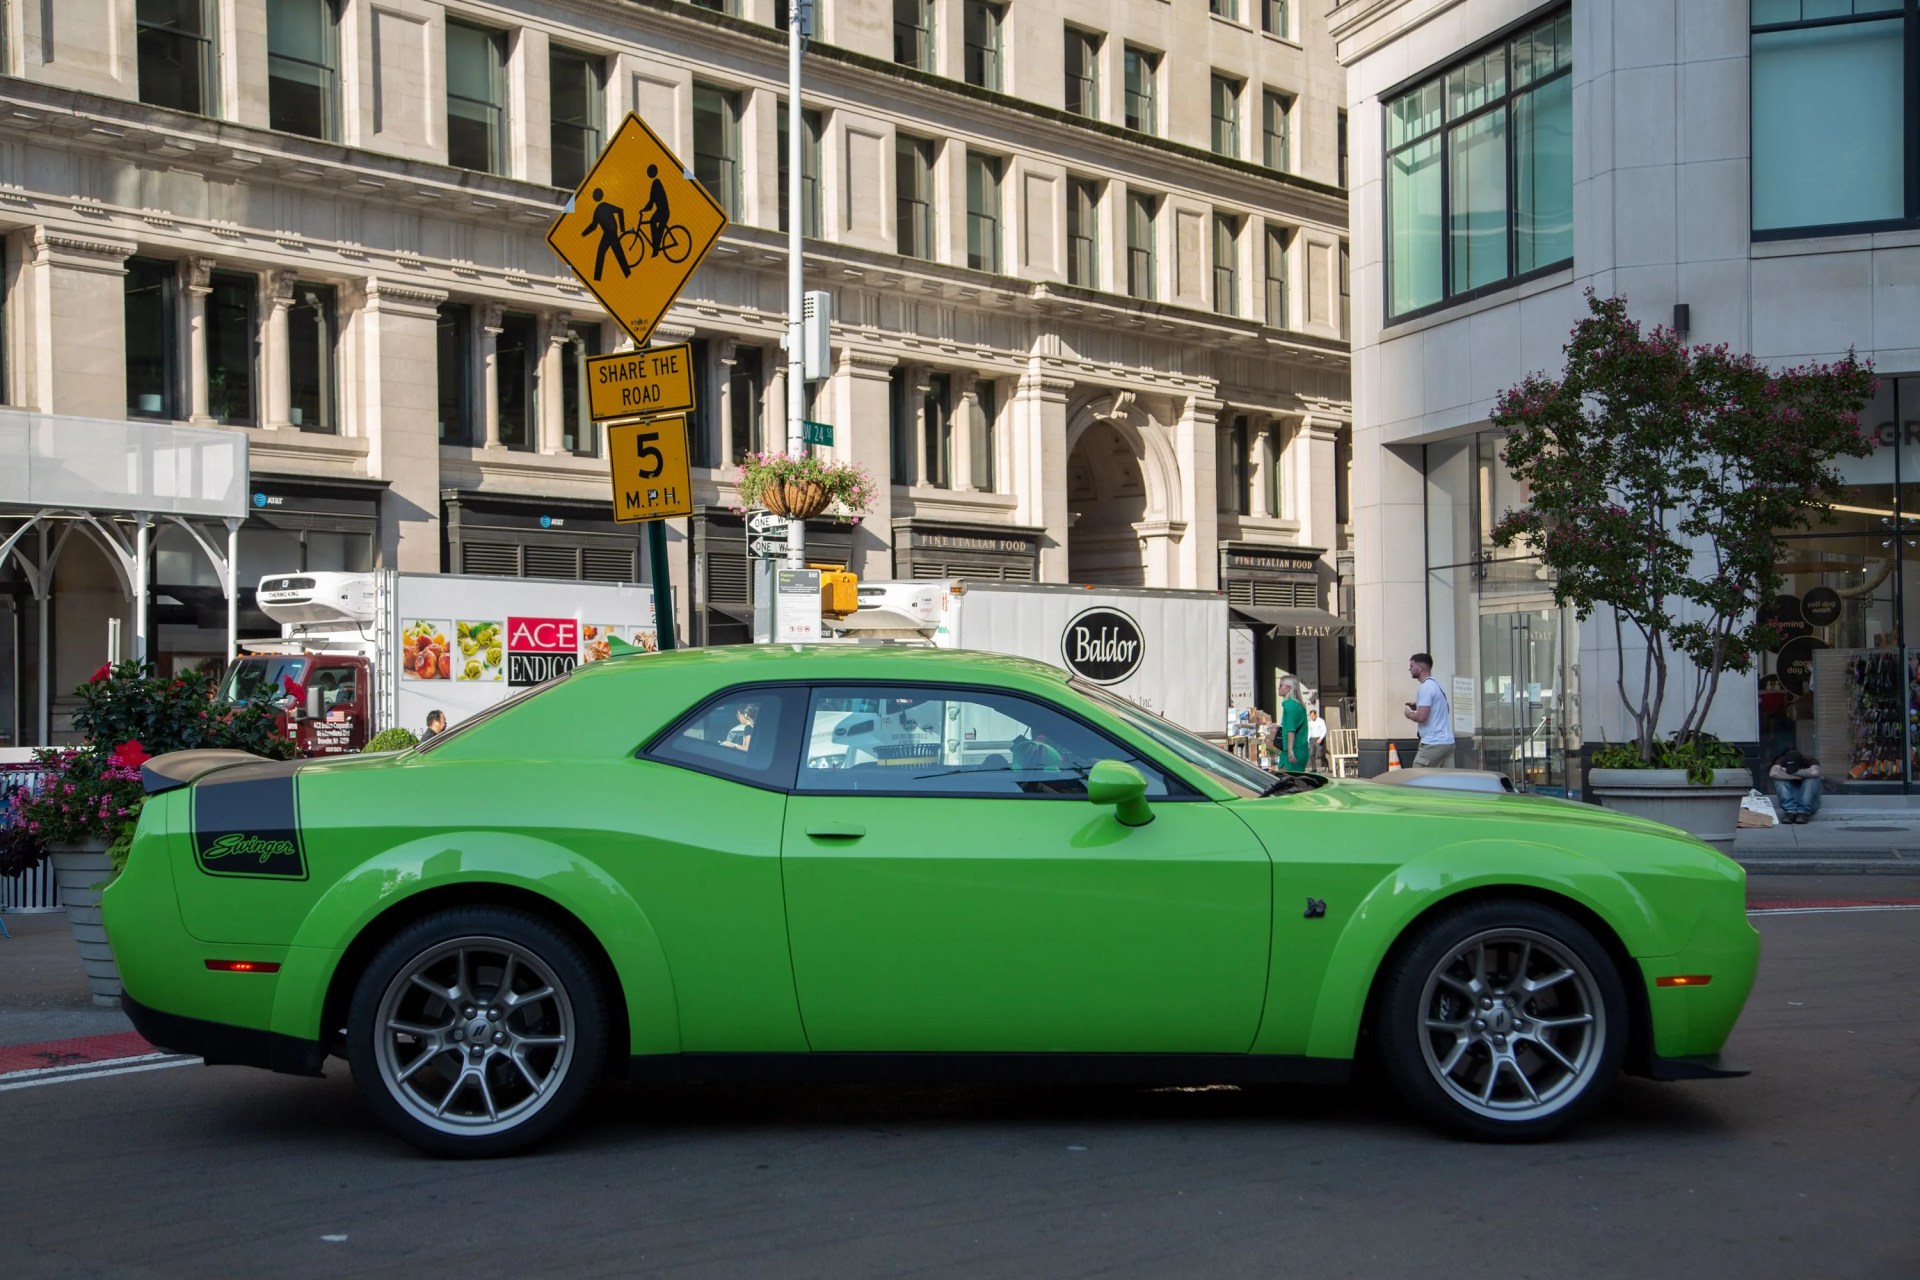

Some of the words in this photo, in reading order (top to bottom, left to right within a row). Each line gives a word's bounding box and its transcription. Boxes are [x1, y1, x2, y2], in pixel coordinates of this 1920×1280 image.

[600, 361, 647, 384] SHARE
[652, 356, 679, 376] THE
[622, 384, 660, 406] ROAD
[815, 425, 824, 442] 24
[637, 432, 664, 479] 5
[626, 487, 680, 509] M.P.H.
[755, 517, 770, 528] ONE
[756, 542, 772, 553] ONE
[922, 535, 948, 546] FINE
[952, 537, 996, 550] ITALIAN
[1000, 540, 1026, 551] FOOD
[1235, 556, 1255, 566] FINE
[1257, 557, 1290, 568] ITALIAN
[1292, 559, 1313, 569] FOOD
[1821, 600, 1836, 608] dog
[510, 622, 576, 648] ACE
[1295, 625, 1330, 637] EATALY
[1075, 626, 1137, 662] Baldor
[510, 656, 575, 682] ENDICO
[1787, 666, 1803, 676] day
[203, 833, 295, 863] Swinger
